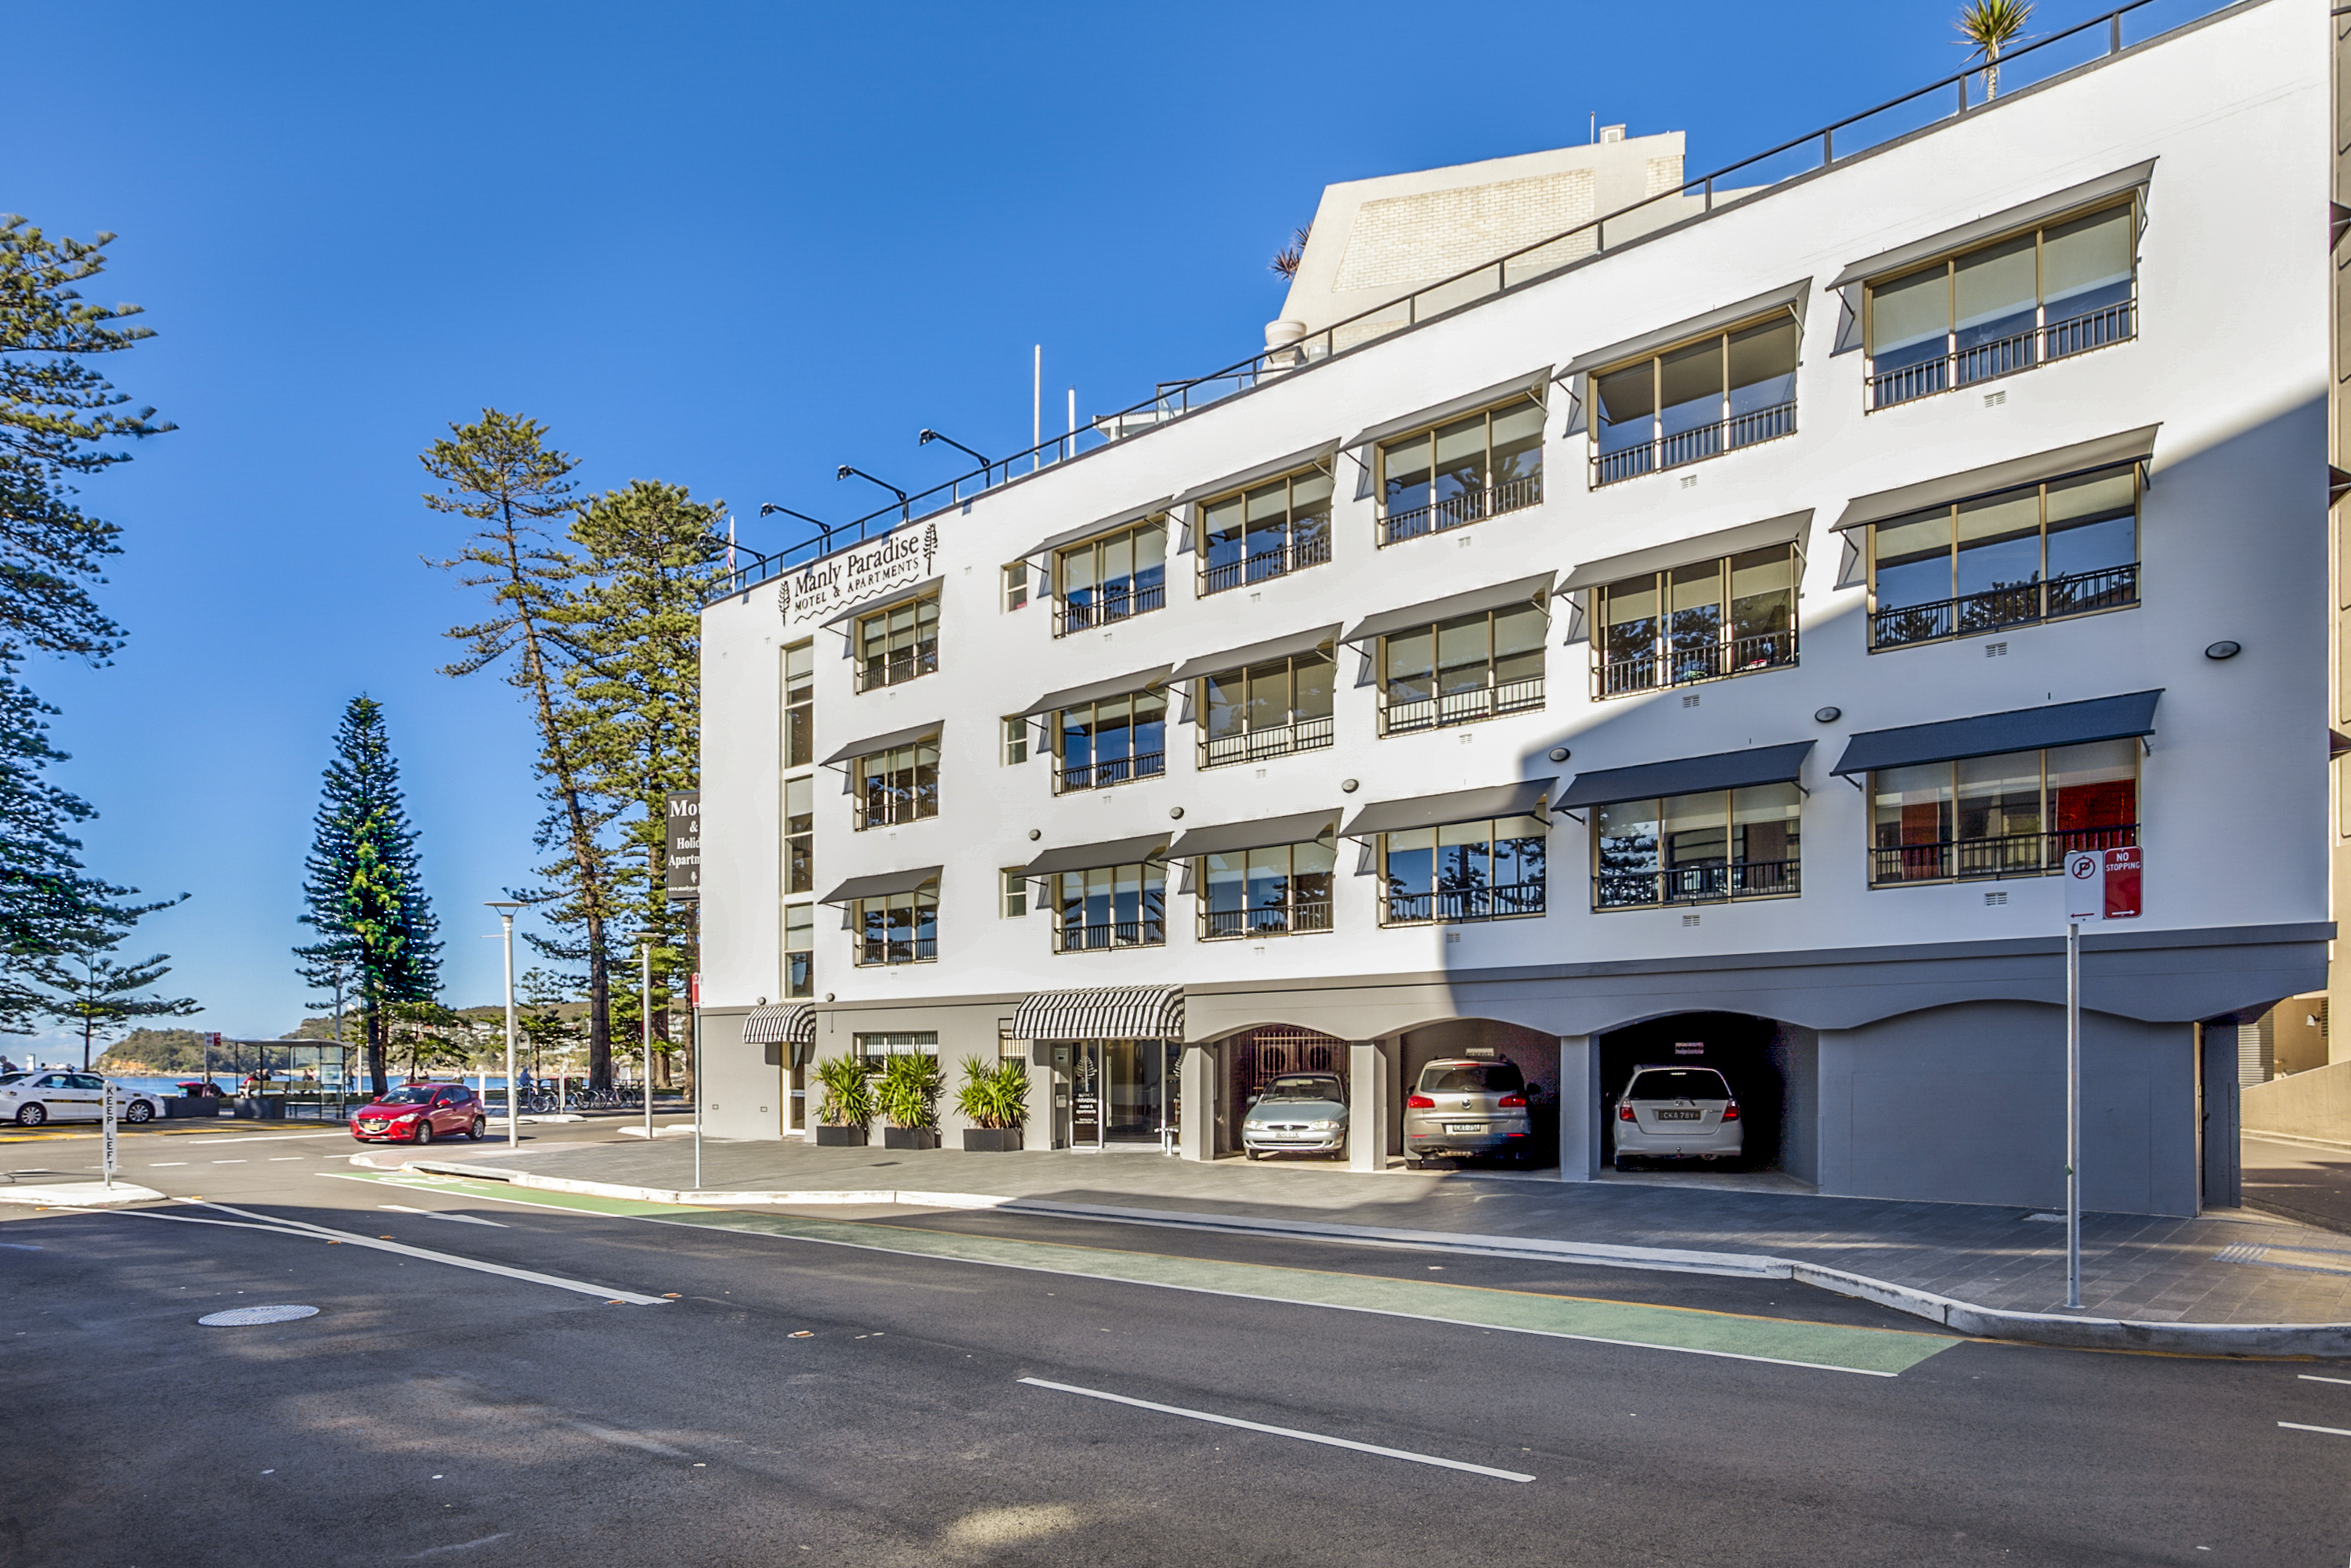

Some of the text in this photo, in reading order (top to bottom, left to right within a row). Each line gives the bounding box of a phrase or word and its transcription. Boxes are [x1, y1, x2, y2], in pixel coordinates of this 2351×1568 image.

[795, 536, 919, 597] Manly Paradise
[795, 558, 919, 612] MOTEL & APARTMENTS
[689, 820, 699, 833] &
[2116, 852, 2129, 862] NO
[2079, 862, 2090, 876] P
[2106, 862, 2140, 872] STOPPING
